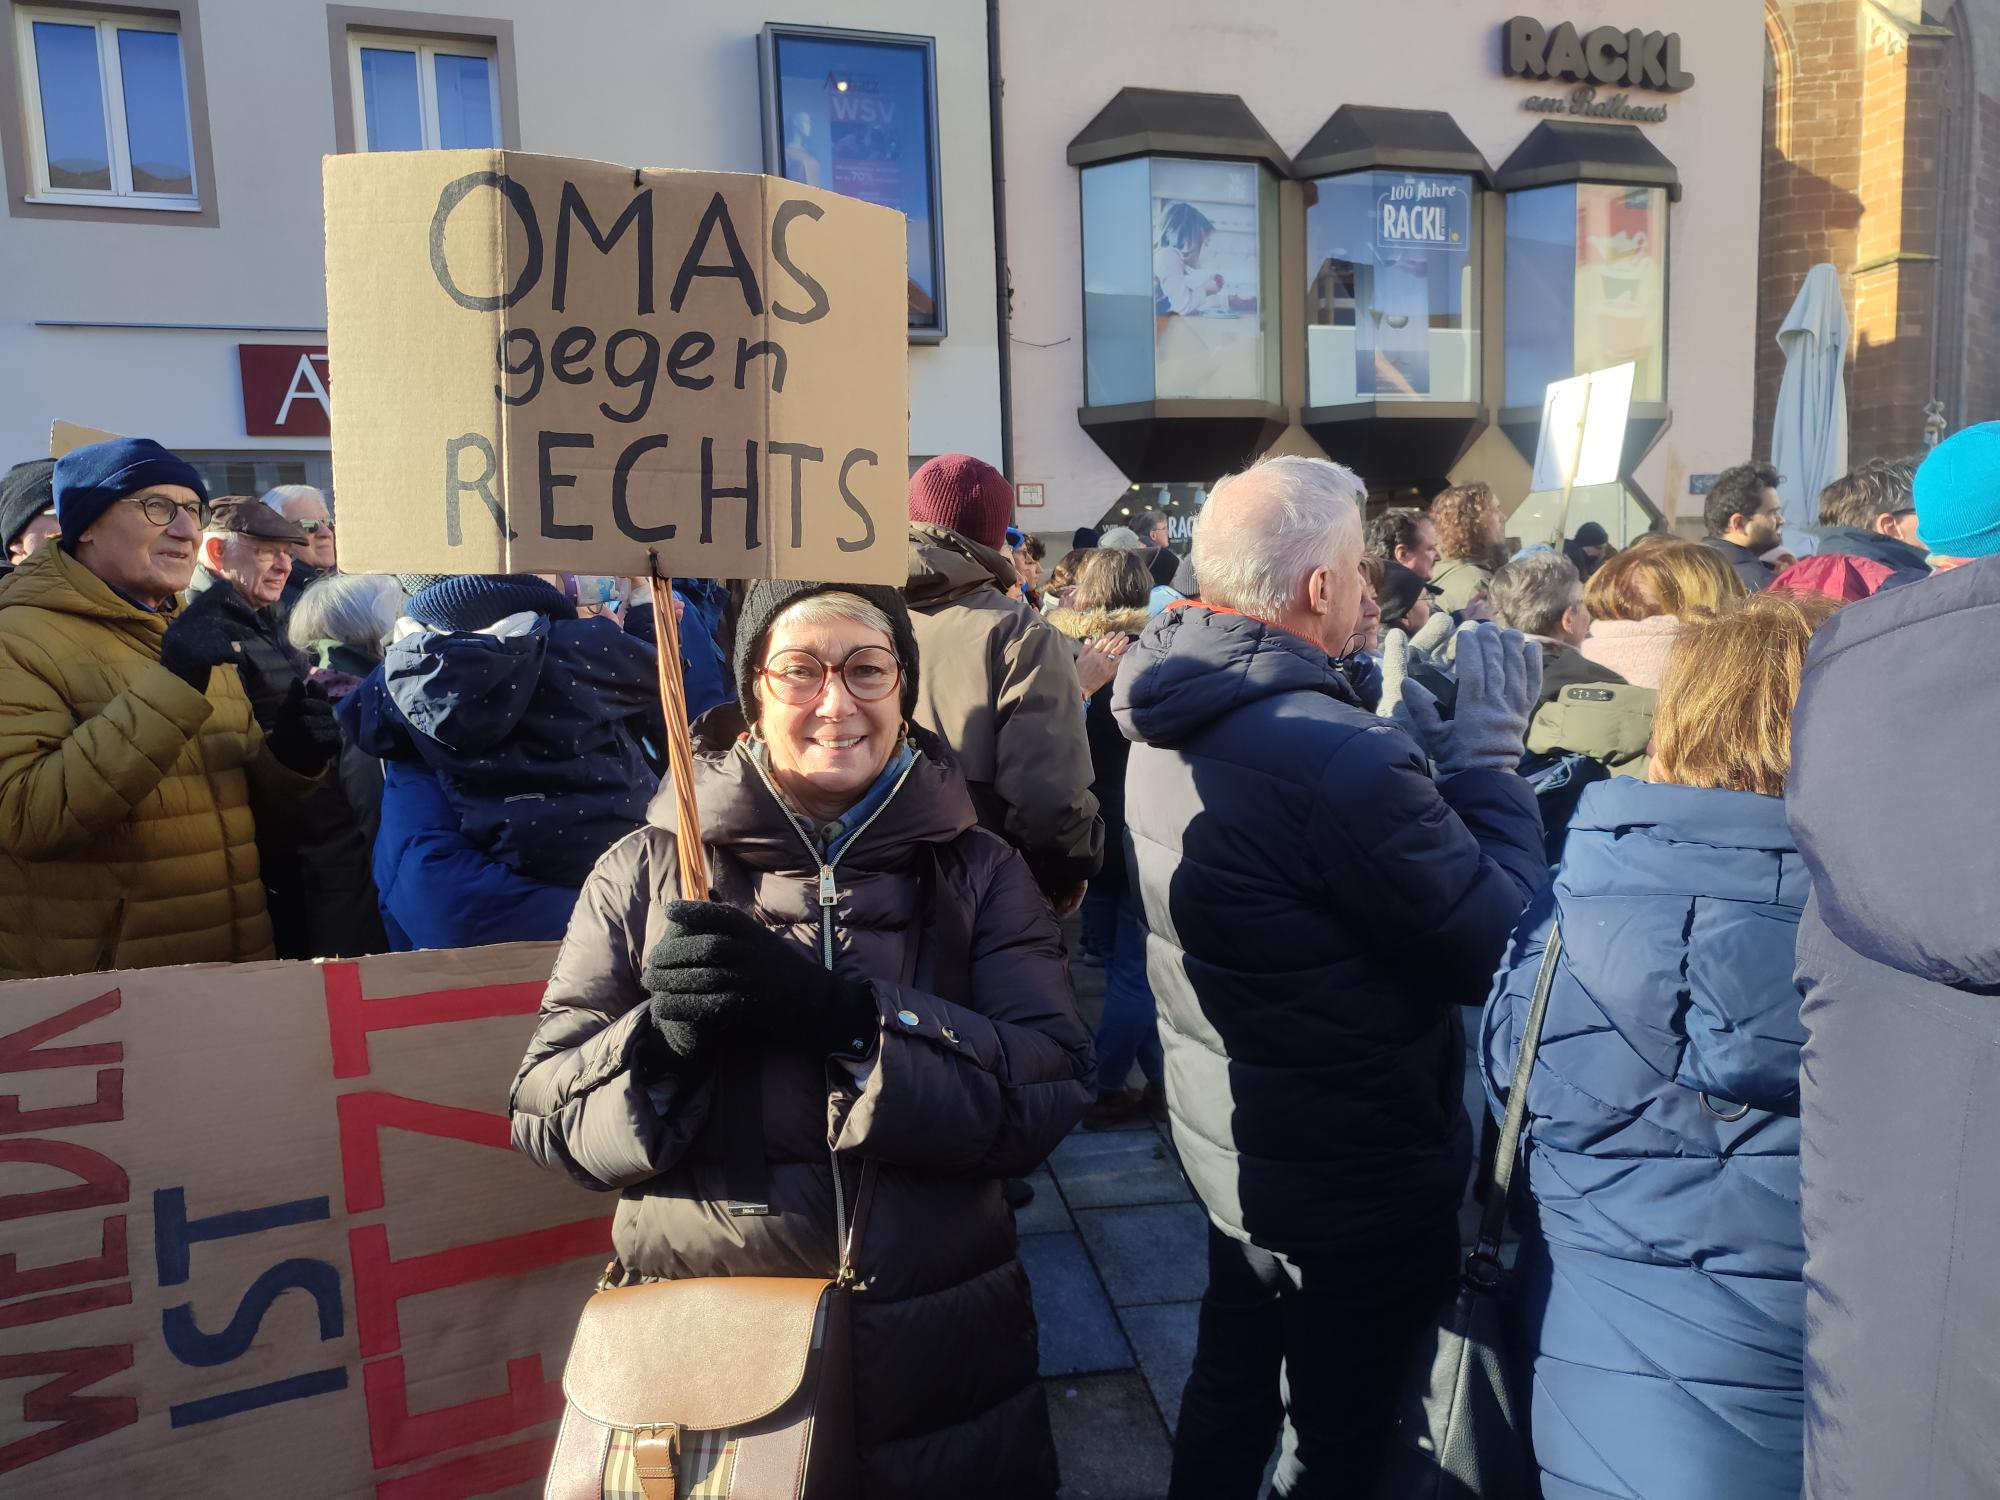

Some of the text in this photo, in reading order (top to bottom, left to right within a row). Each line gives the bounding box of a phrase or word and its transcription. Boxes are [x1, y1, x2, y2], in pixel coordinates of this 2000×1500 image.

[1502, 16, 1695, 93] RACKL
[832, 96, 896, 124] WSV
[1383, 203, 1446, 241] RACKL
[1391, 181, 1458, 202] 100 Jahre
[430, 171, 830, 324] OMAS
[494, 326, 788, 423] gegen
[446, 430, 878, 553] RECHTS
[153, 1186, 349, 1429] IST
